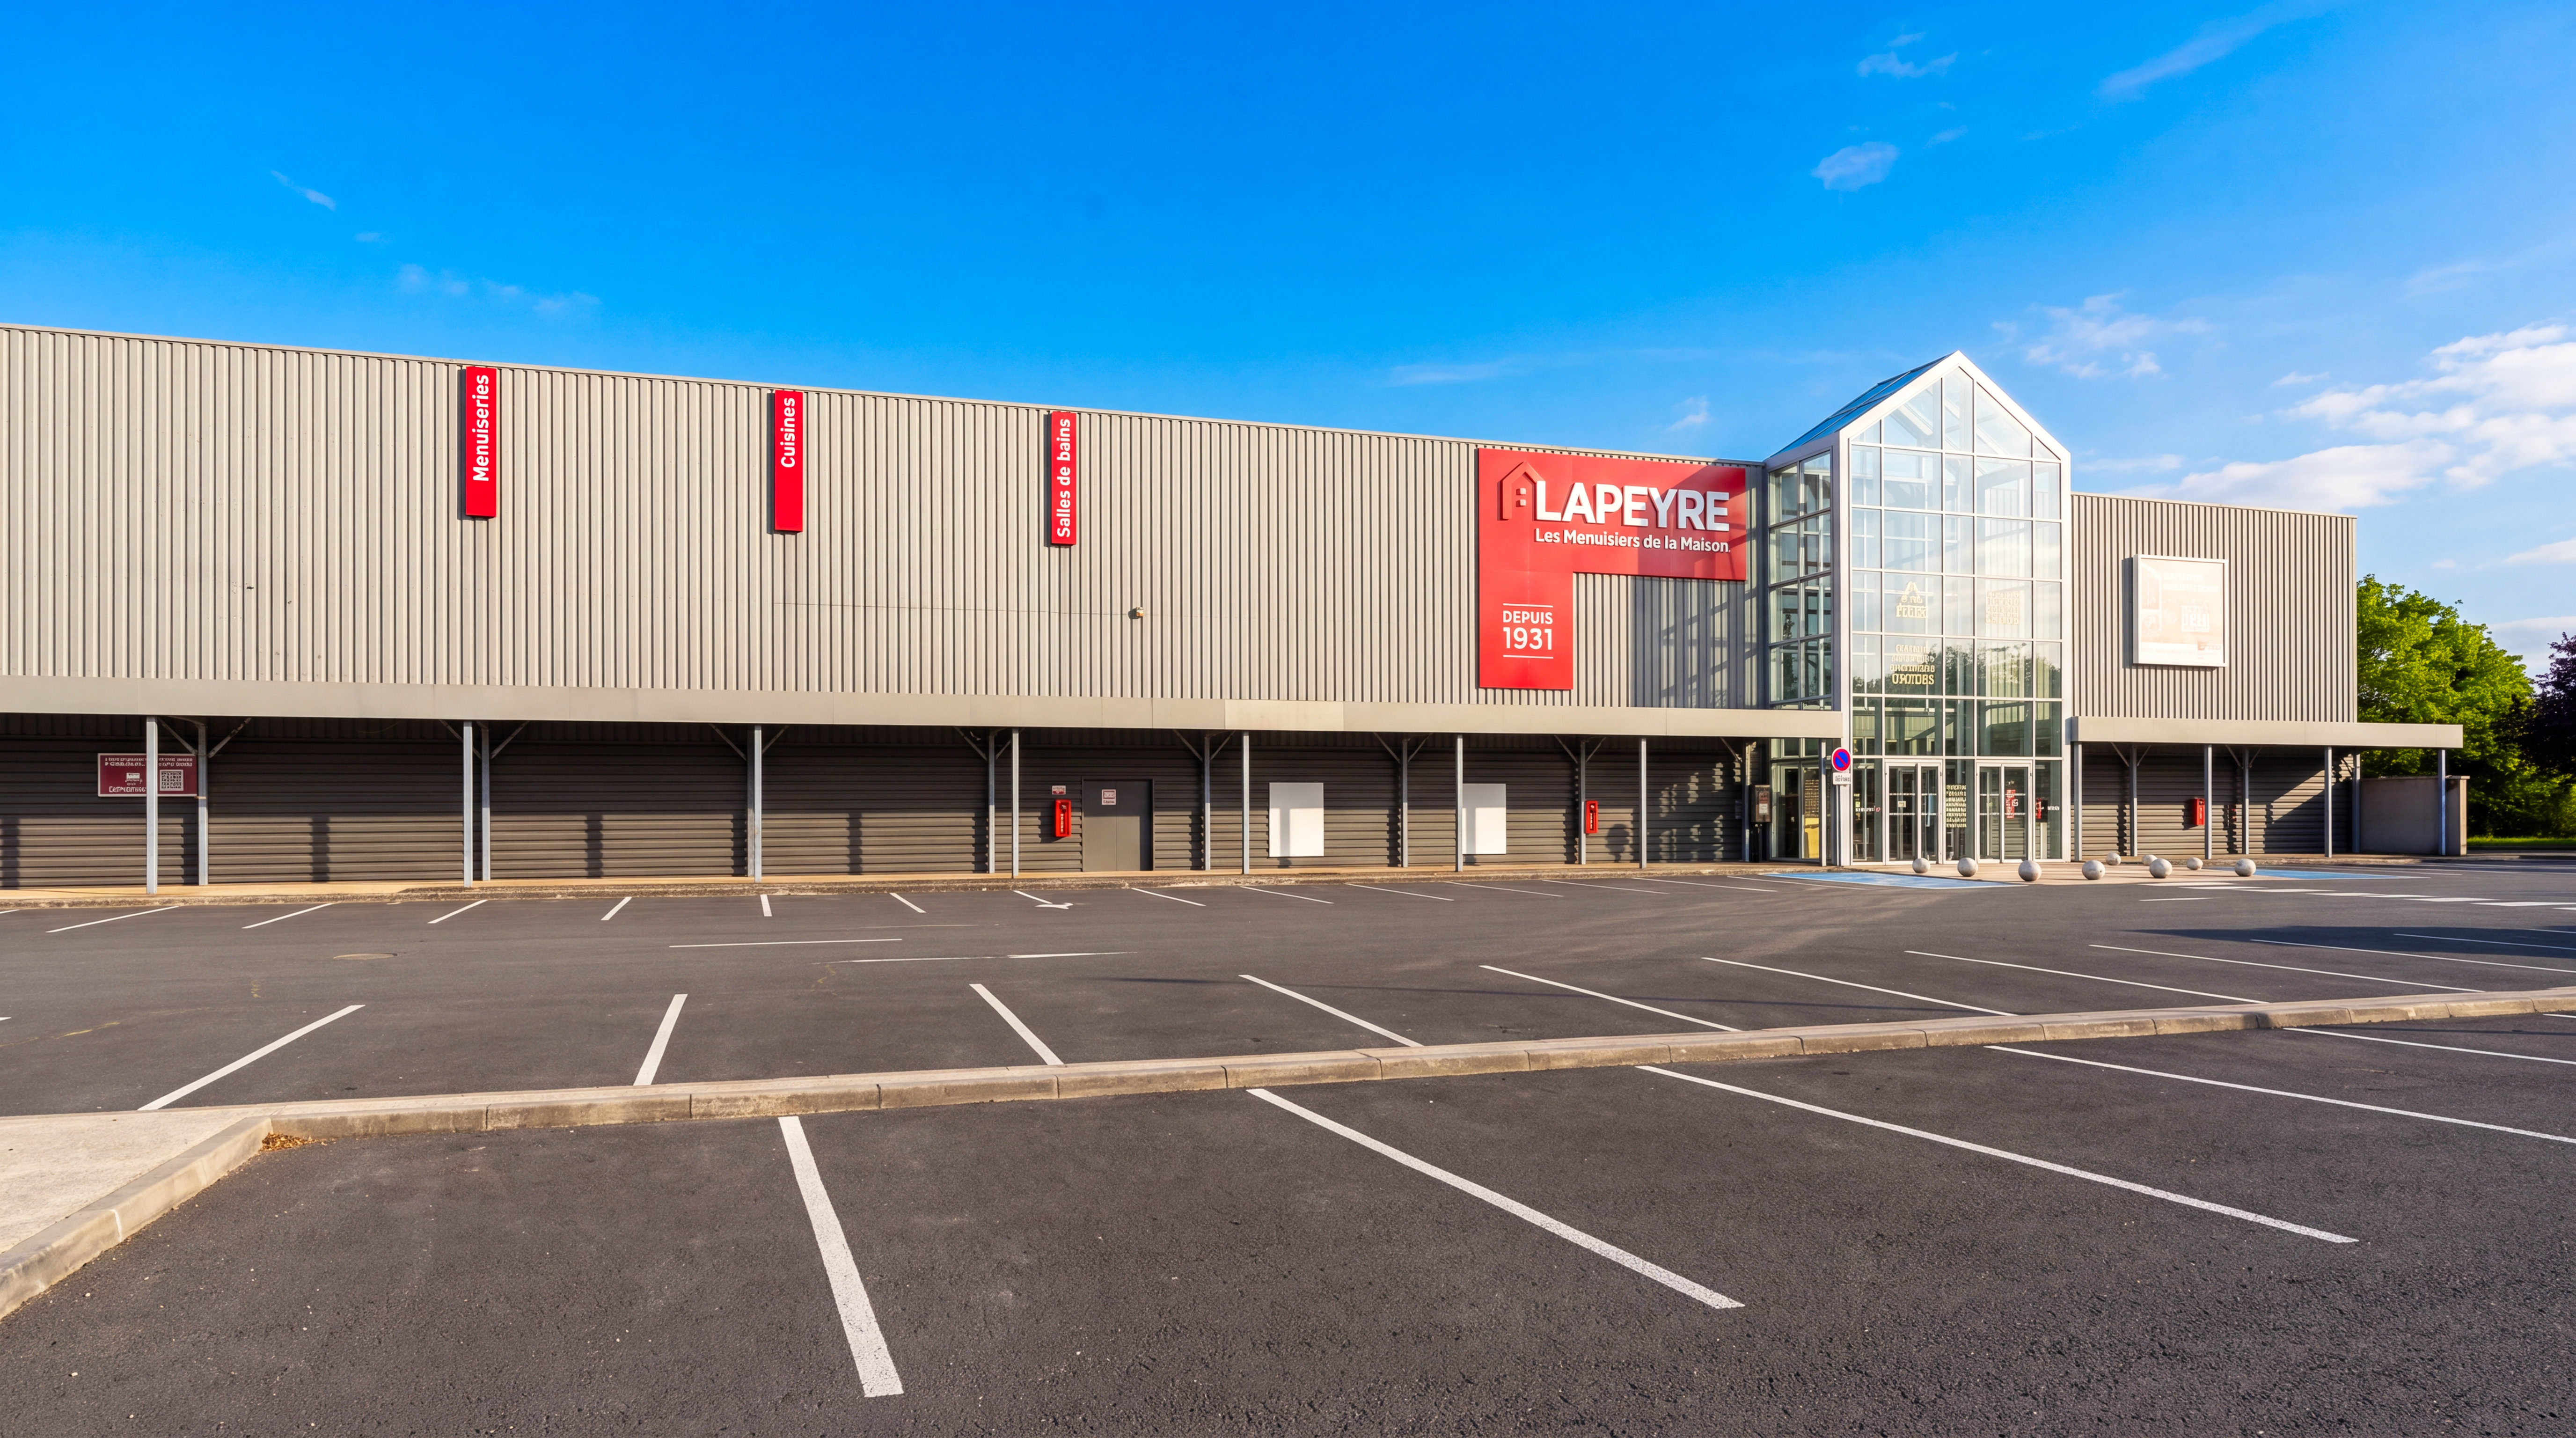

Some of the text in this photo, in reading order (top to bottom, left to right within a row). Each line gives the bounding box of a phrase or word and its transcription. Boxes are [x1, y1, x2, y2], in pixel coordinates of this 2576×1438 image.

[472, 375, 489, 481] Menuiseries
[780, 398, 795, 468] Cuisines
[1056, 419, 1071, 537] Salles de bains
[1536, 480, 1729, 531] LAPEYRE
[1536, 528, 1560, 543] Les
[1564, 529, 1640, 547] Menuisiers
[1644, 535, 1661, 549] de
[1665, 536, 1677, 550] la
[1503, 610, 1553, 625] DEPUIS
[1503, 627, 1552, 650] 1931
